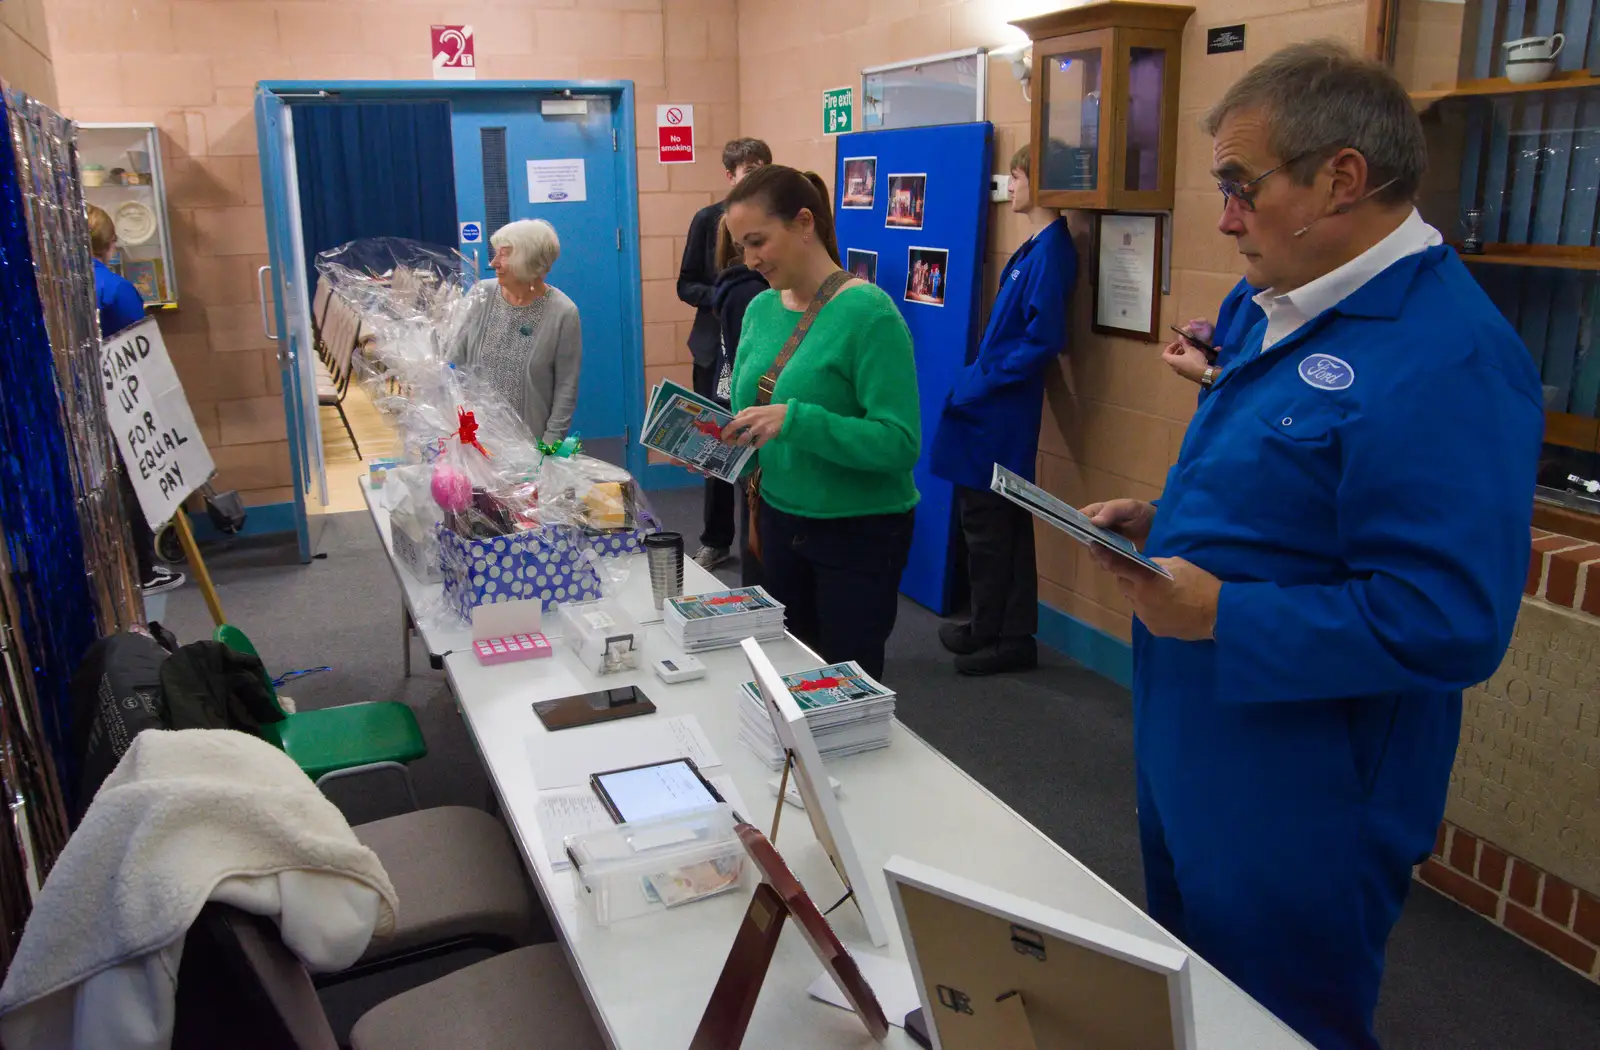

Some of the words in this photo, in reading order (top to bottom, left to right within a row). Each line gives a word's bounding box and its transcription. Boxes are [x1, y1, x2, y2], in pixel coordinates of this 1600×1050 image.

[463, 55, 471, 65] T
[824, 93, 837, 109] Fire
[838, 90, 852, 107] exit
[660, 144, 691, 152] smoking
[670, 135, 681, 143] No
[101, 335, 151, 391] STAND
[1307, 359, 1344, 385] Ford
[119, 375, 139, 414] UP
[128, 411, 157, 458] FOR
[138, 427, 188, 480] EQUAL
[158, 460, 184, 501] PAY
[1507, 646, 1560, 684] THE
